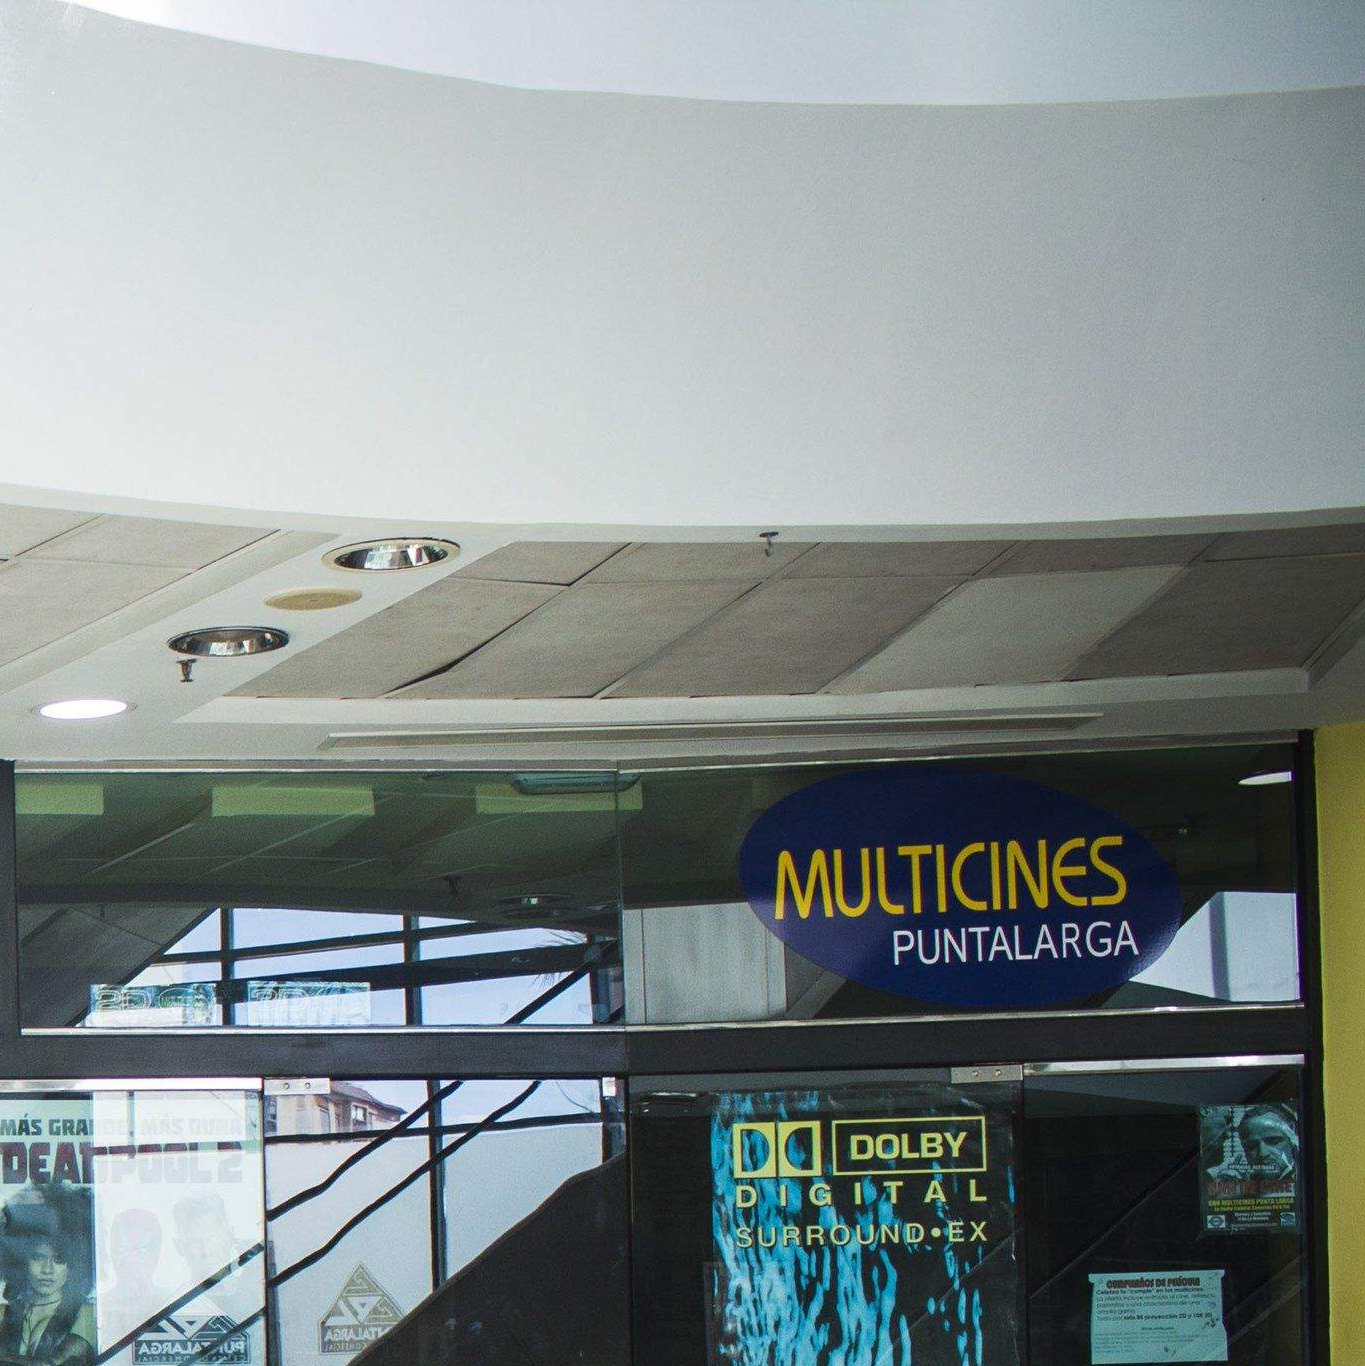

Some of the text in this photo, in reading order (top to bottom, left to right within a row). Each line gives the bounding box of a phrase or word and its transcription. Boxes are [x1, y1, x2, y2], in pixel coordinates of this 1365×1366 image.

[775, 835, 1127, 920] MULTICINES
[893, 920, 1138, 965] PUNTALARGA
[0, 1142, 213, 1184] DEADPOOL
[850, 1132, 966, 1160] DOLBY
[735, 1179, 987, 1208] DIGITAL
